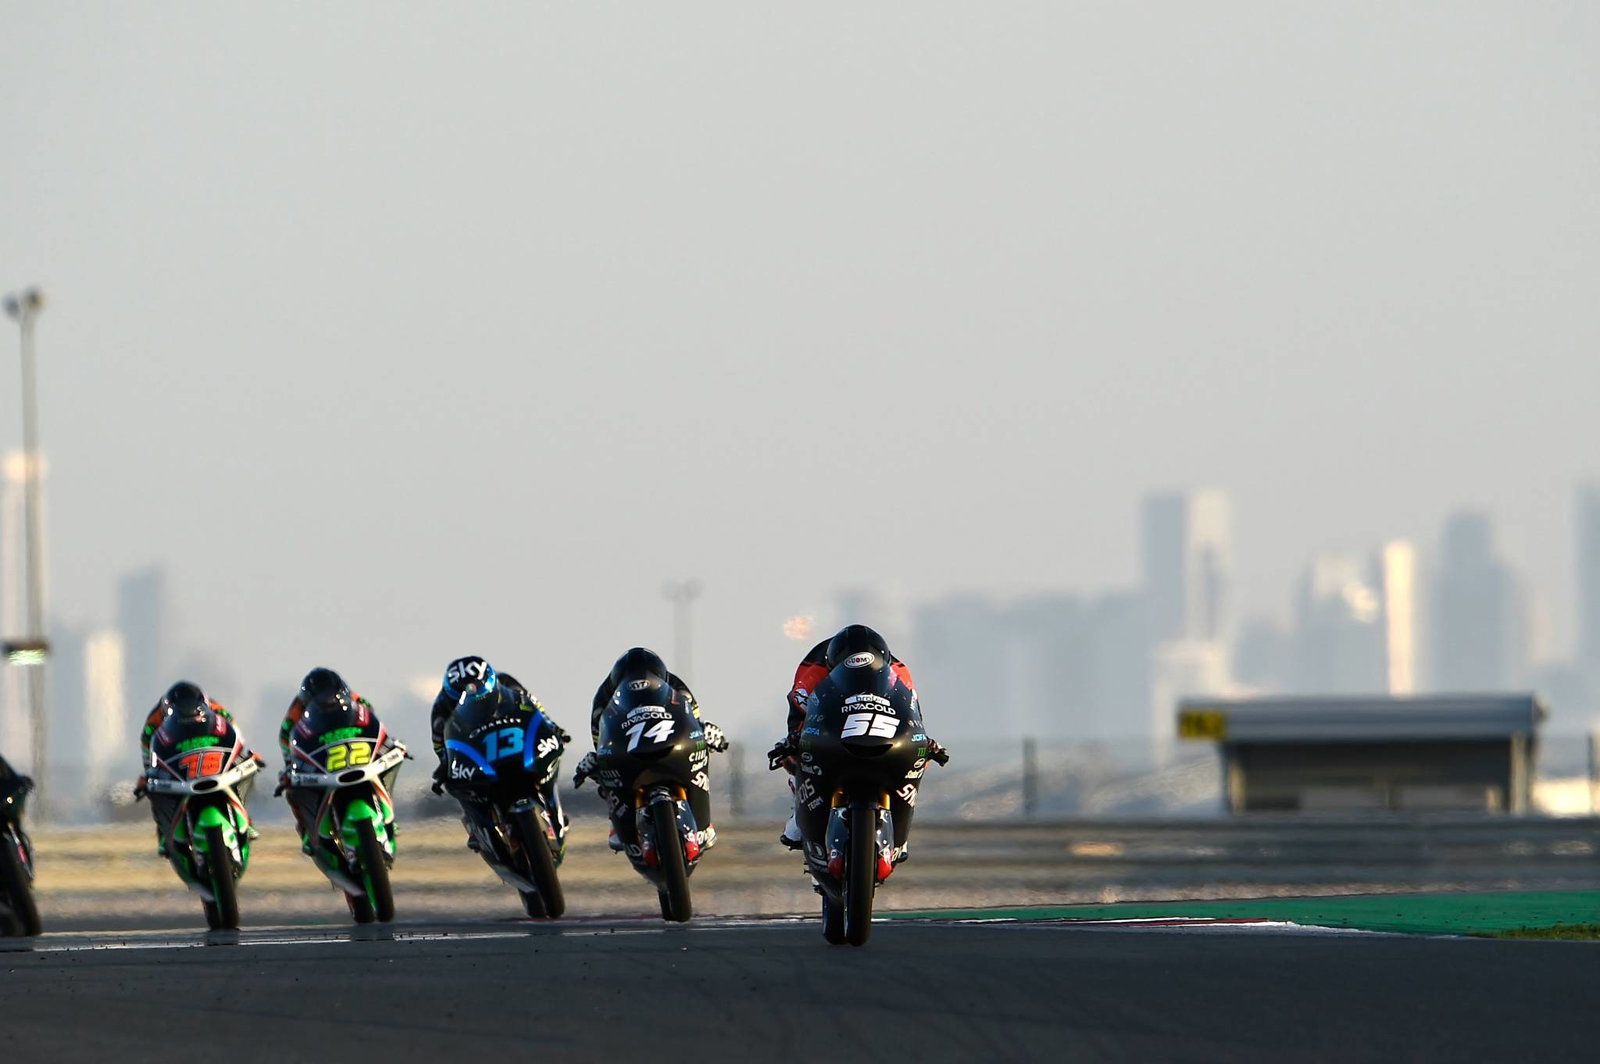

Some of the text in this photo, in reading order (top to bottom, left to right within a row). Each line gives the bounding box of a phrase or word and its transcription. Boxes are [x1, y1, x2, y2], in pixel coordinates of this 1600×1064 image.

[448, 660, 488, 683] sky
[621, 711, 673, 729] RIVACOLD
[841, 702, 897, 716] RIVACOLD
[625, 719, 676, 753] 14
[840, 712, 900, 740] 55
[326, 741, 371, 773] 22
[482, 726, 525, 764] 13
[451, 762, 476, 781] sky
